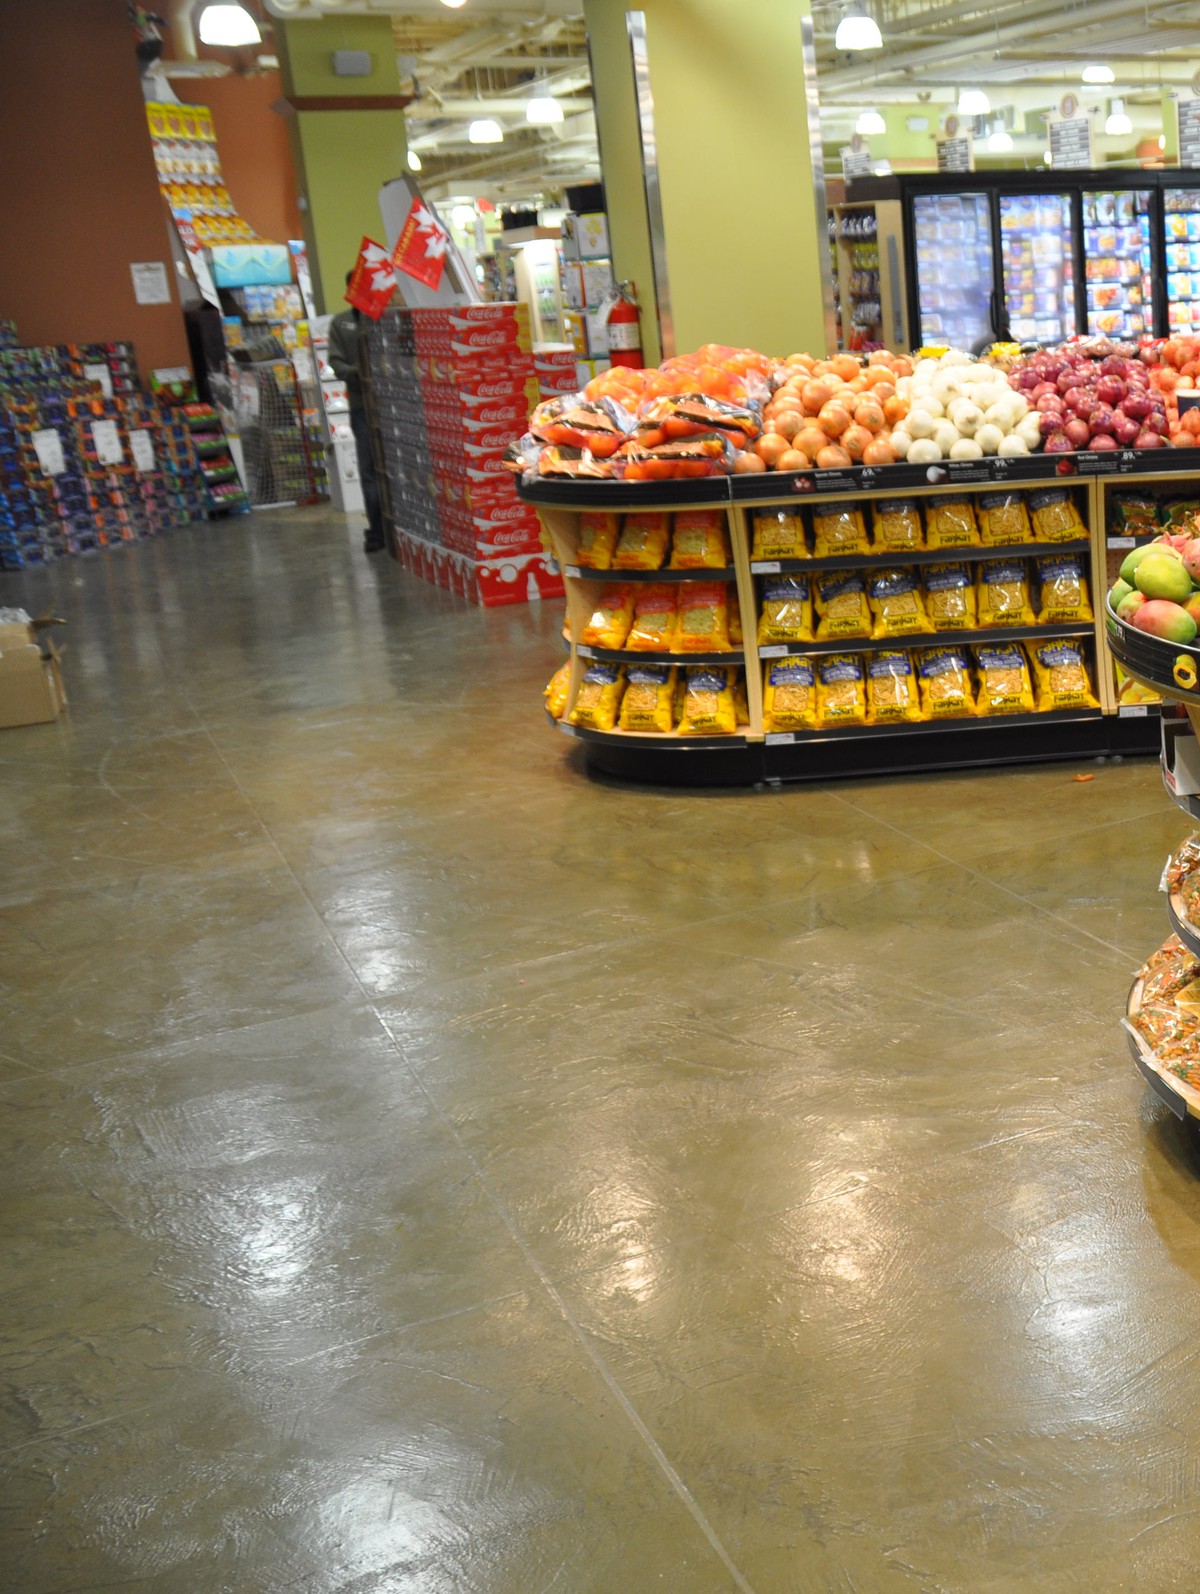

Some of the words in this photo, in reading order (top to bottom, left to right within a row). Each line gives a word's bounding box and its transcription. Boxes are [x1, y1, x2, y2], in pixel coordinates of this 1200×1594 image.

[467, 307, 503, 320] Coca-Cola
[469, 330, 506, 346] Coca-Cola
[478, 381, 514, 397] Coca-Cola
[480, 406, 517, 422] Coca-Cola
[482, 431, 518, 446] Coca-Cola
[491, 504, 527, 520] Coca-Cola
[494, 528, 529, 545] Coca-Cola
